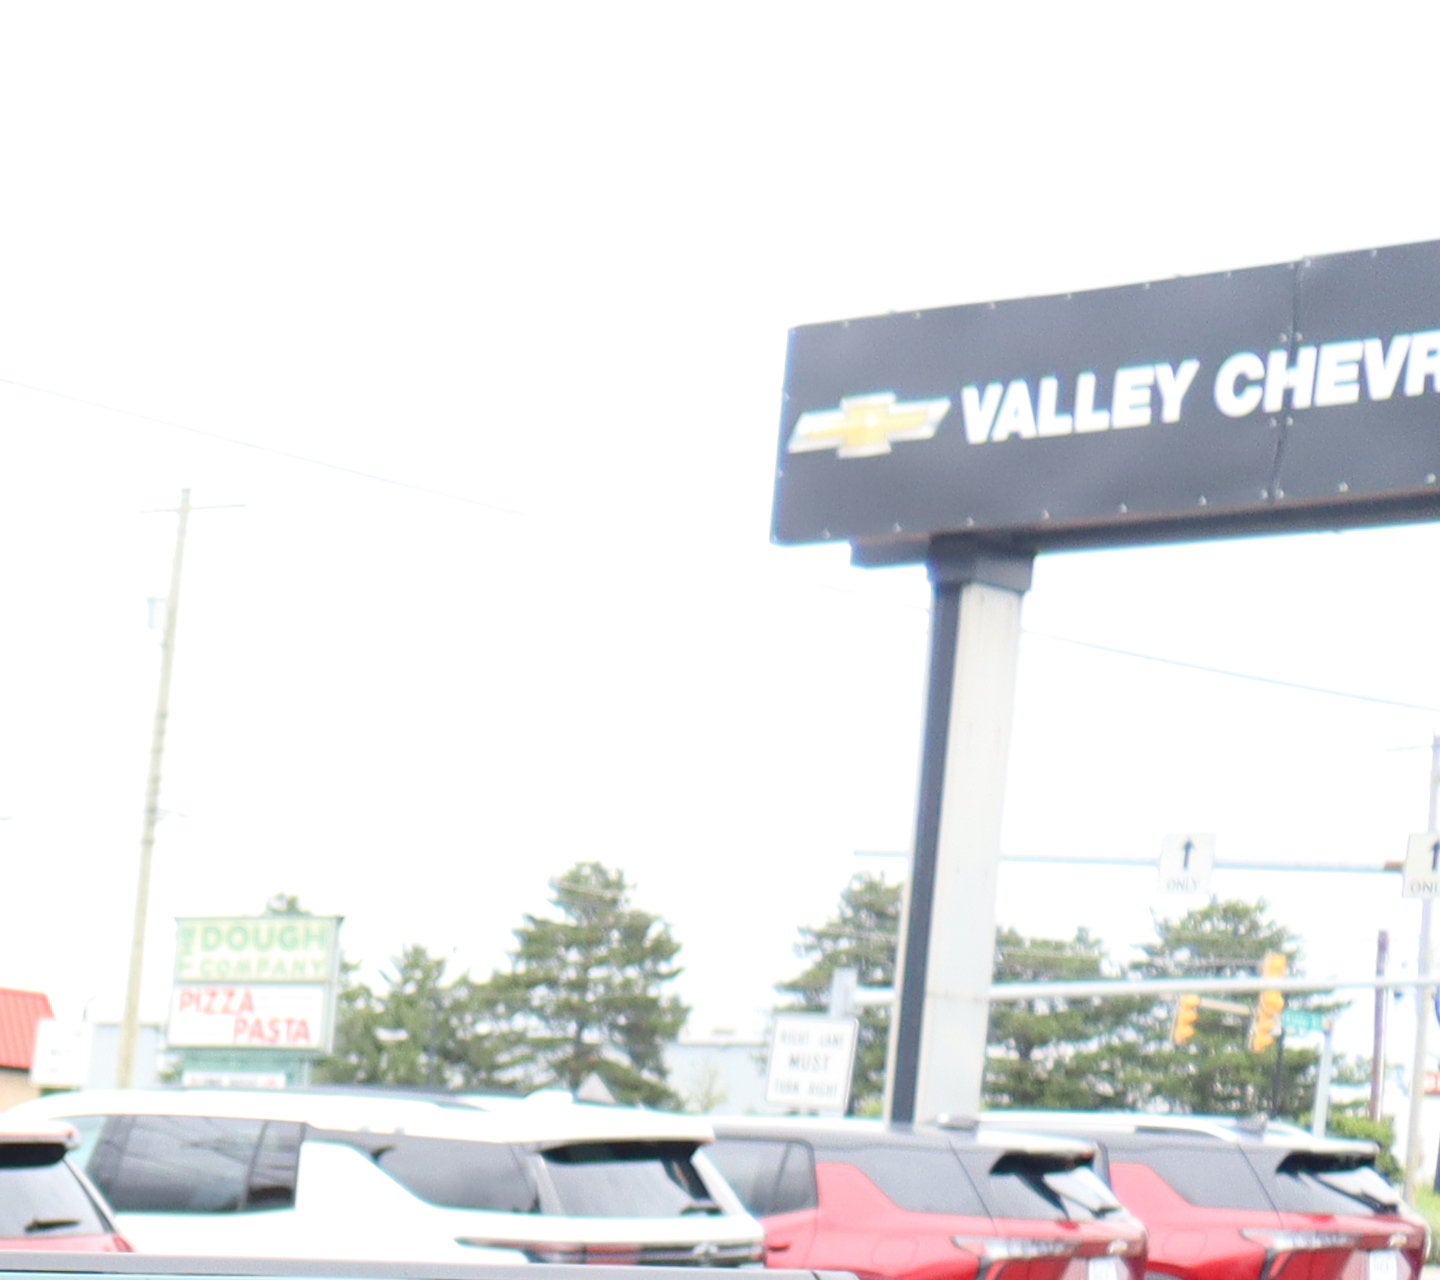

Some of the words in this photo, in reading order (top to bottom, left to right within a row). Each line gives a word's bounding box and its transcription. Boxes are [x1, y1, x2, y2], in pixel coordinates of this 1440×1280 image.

[961, 359, 1200, 445] VALLEY
[1166, 878, 1201, 893] ONLY
[200, 924, 327, 952] DOUGH
[178, 986, 256, 1015] PIZZA
[233, 1016, 311, 1043] PASTA
[788, 1052, 830, 1073] MUST
